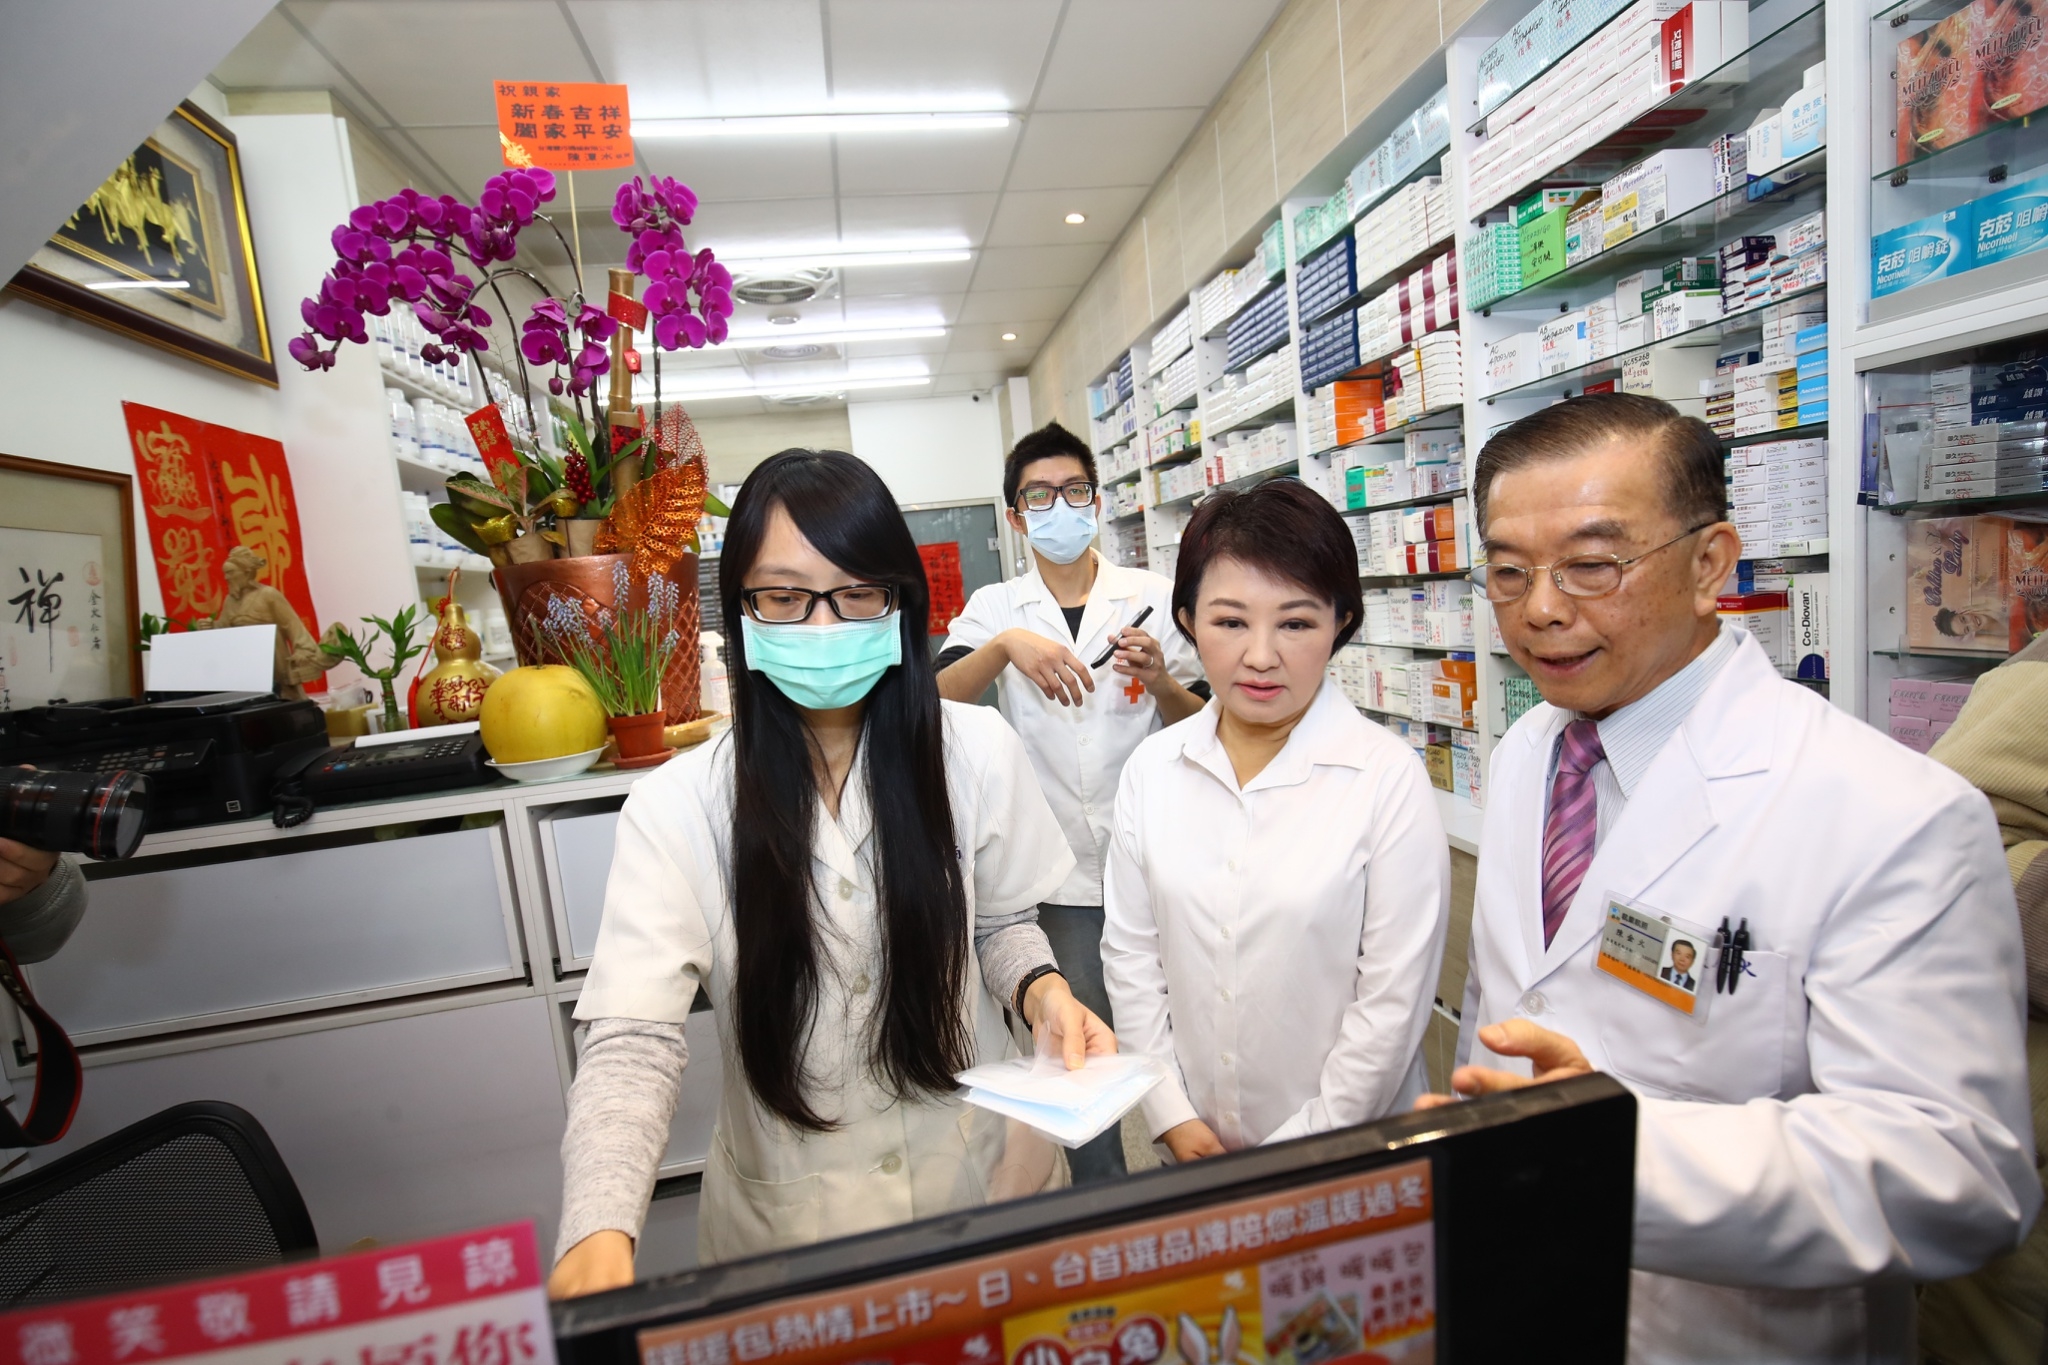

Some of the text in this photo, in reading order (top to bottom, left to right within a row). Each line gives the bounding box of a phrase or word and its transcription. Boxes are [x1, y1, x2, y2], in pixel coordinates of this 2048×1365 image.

[499, 85, 561, 98] 祝親家
[511, 103, 621, 121] 新春吉祥
[1792, 112, 1818, 130] Actein
[514, 122, 623, 140] 闔家平安
[1979, 211, 2014, 242] 克菸
[1878, 237, 1950, 274] 克菸 咀嚼錠
[1490, 345, 1499, 356] AC
[1942, 530, 1969, 577] Lady
[1923, 558, 1942, 607] Golden
[8, 567, 64, 673] 禪
[1802, 592, 1811, 647] Co-Diovan
